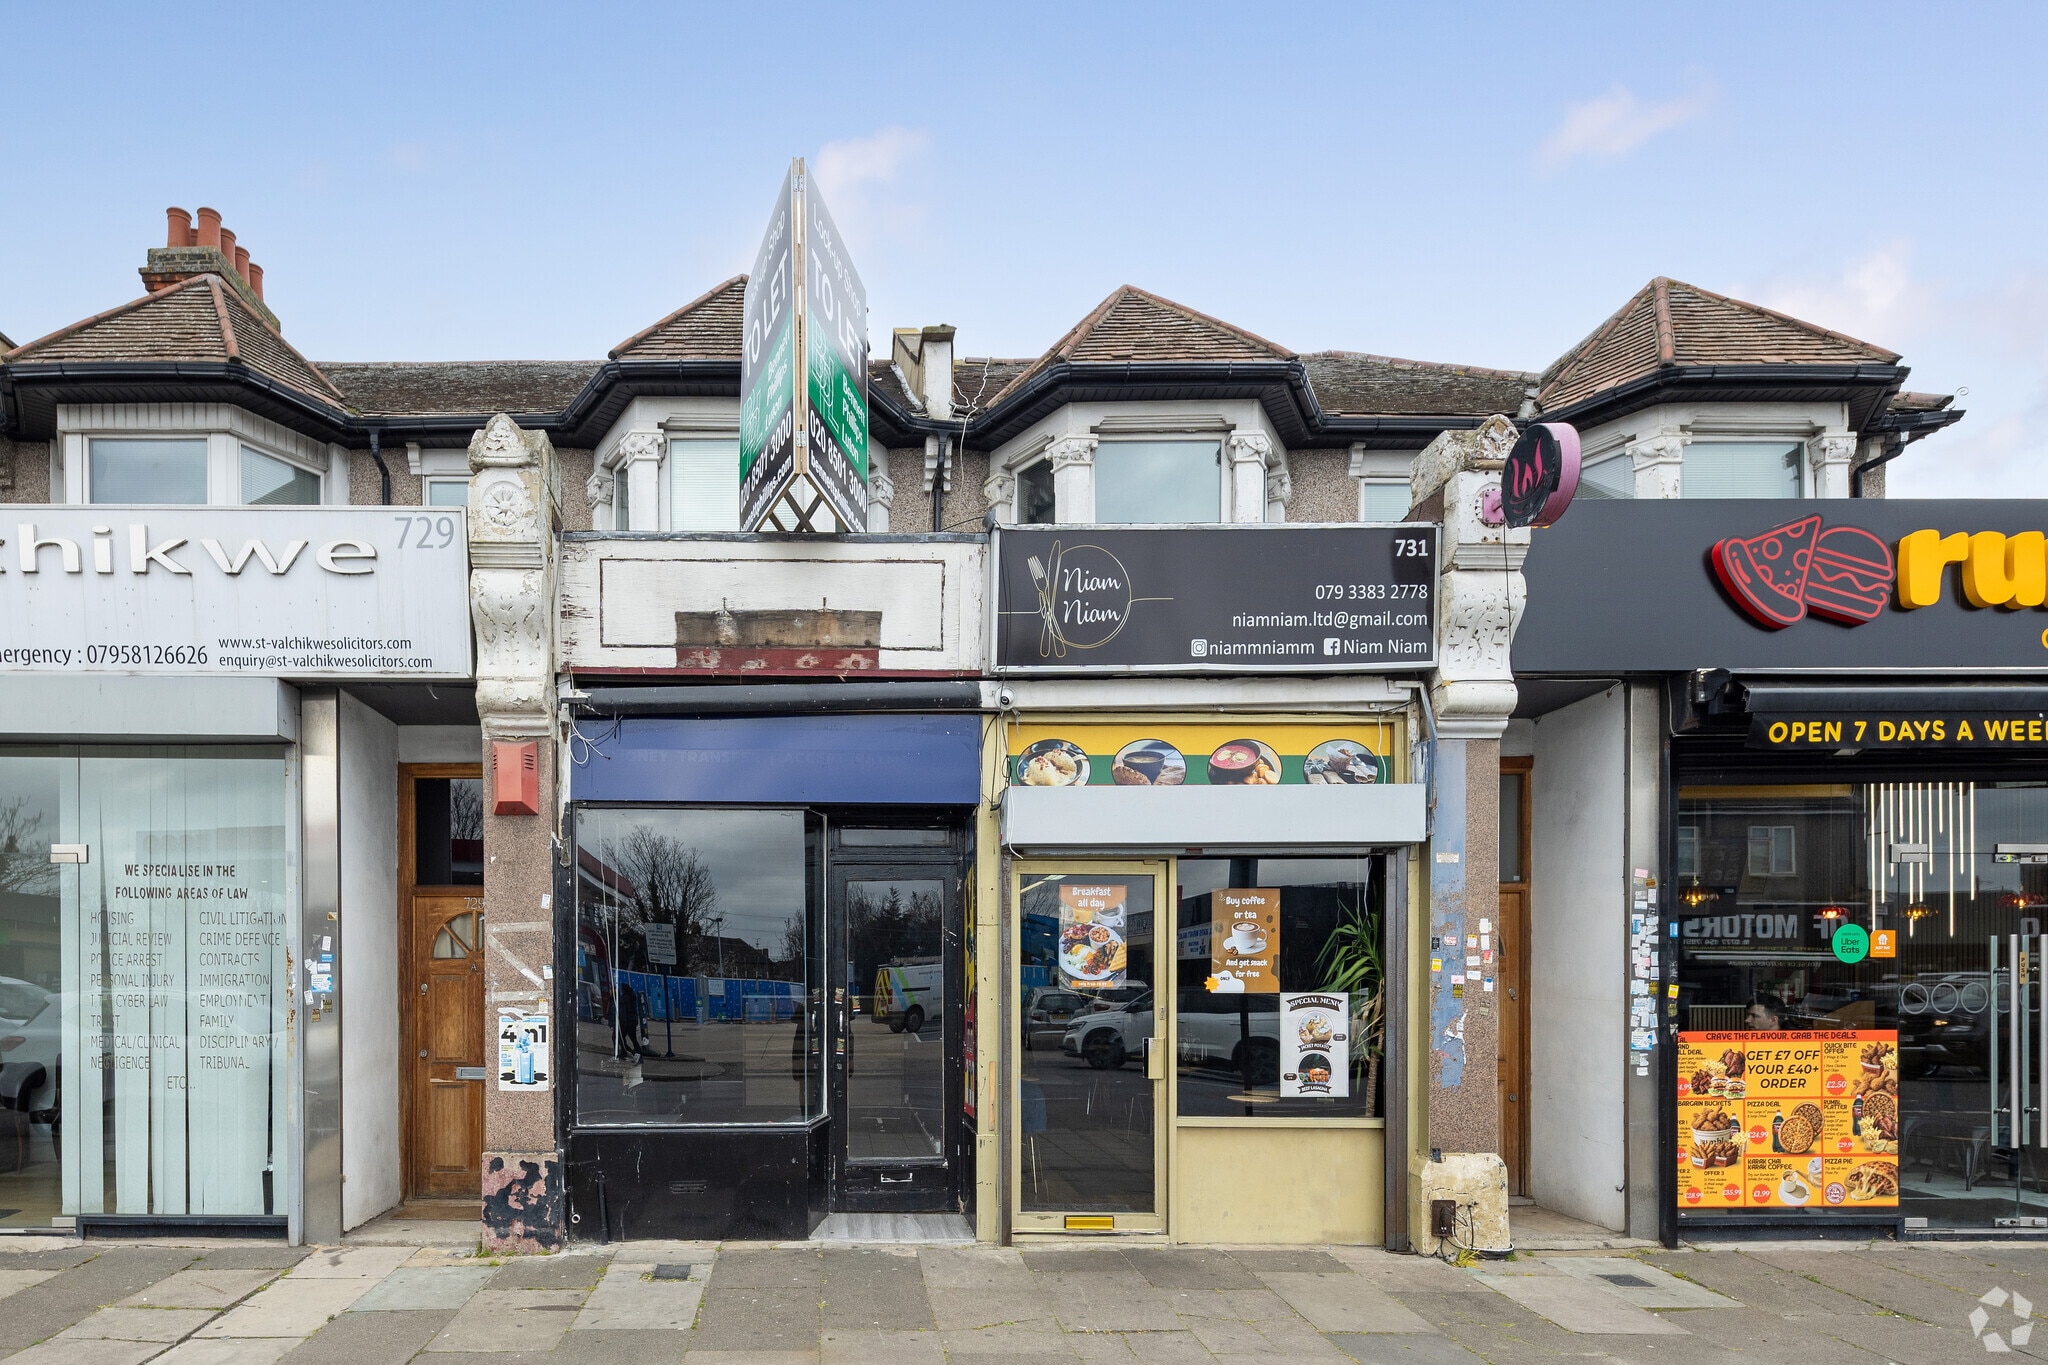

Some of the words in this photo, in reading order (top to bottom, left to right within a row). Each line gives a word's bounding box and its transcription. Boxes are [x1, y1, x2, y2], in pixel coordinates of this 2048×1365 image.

[768, 210, 785, 260] Shop
[745, 319, 760, 378] TO
[763, 248, 788, 341] LET
[811, 249, 833, 321] TO
[838, 299, 863, 377] LET
[751, 445, 768, 491] 8501
[770, 410, 791, 461] 3000
[810, 410, 826, 453] 020
[827, 437, 846, 485] 8501
[848, 470, 866, 513] 3000
[394, 517, 455, 550] 729
[0, 524, 377, 575] hikwe
[1395, 539, 1429, 557] 731
[1898, 529, 2048, 609] ru
[1063, 567, 1122, 593] Niam
[1316, 584, 1344, 600] 079
[1348, 584, 1386, 600] 3383
[1390, 584, 1428, 600] 2778
[1063, 599, 1122, 625] Niam
[1232, 611, 1428, 629] niamniam.ltd@gmail.com
[218, 636, 412, 650] www.st-valchikwesolicitors.com
[1210, 640, 1315, 656] niammniamm
[1344, 640, 1383, 655] Niam
[1388, 640, 1427, 655] Niam
[87, 645, 208, 664] 07958126626
[219, 655, 433, 669] enquiry@st-valchikwesolicitors.com
[1768, 721, 1842, 743] OPEN
[1854, 721, 1867, 742] 7
[1878, 721, 1946, 742] DAYS
[1956, 721, 1974, 741] A
[1983, 720, 2048, 741] WEE
[125, 864, 140, 877] WE
[142, 864, 200, 877] SPECIALISE
[203, 865, 213, 877] IN
[216, 865, 235, 877] THE
[115, 887, 172, 899] FOLLOWING
[176, 887, 208, 900] AREAS
[212, 887, 224, 900] OF
[227, 887, 248, 900] LAW
[1072, 887, 1111, 896] Breakfast
[1078, 899, 1088, 907] all
[1090, 898, 1105, 910] day
[1226, 896, 1240, 907] Buy
[1242, 896, 1265, 905] coffee
[200, 912, 227, 925] CIVIL
[1244, 910, 1257, 919] tea
[136, 932, 172, 946] REVIEW
[200, 932, 231, 946] CRIME
[235, 932, 280, 946] DEFENCE
[1841, 938, 1860, 946] Uber
[91, 953, 123, 966] POCE
[127, 953, 162, 966] ARREST
[200, 953, 260, 966] CONTRACTS
[1239, 959, 1250, 968] get
[91, 974, 138, 987] PESONAL
[142, 974, 174, 987] INJURY
[200, 974, 269, 987] IMMIGRATION
[1235, 970, 1245, 978] for
[1246, 970, 1260, 978] free
[116, 994, 145, 1007] CYBER
[1290, 997, 1319, 1007] SPECIAL
[91, 1015, 120, 1028] TRT
[200, 1015, 234, 1028] FAMILY
[1706, 1032, 1732, 1040] CRAVE
[1734, 1032, 1750, 1040] THE
[1751, 1032, 1789, 1040] FLAVOUR.
[1746, 1051, 1772, 1060] GET
[1775, 1051, 1791, 1060] £7
[1794, 1050, 1820, 1060] OFF
[200, 1056, 250, 1069] TRIBUNA
[1748, 1065, 1784, 1074] YOUR
[1787, 1064, 1819, 1074] £40+
[1760, 1079, 1806, 1088] ORDER
[1753, 1190, 1770, 1198] £1.99
